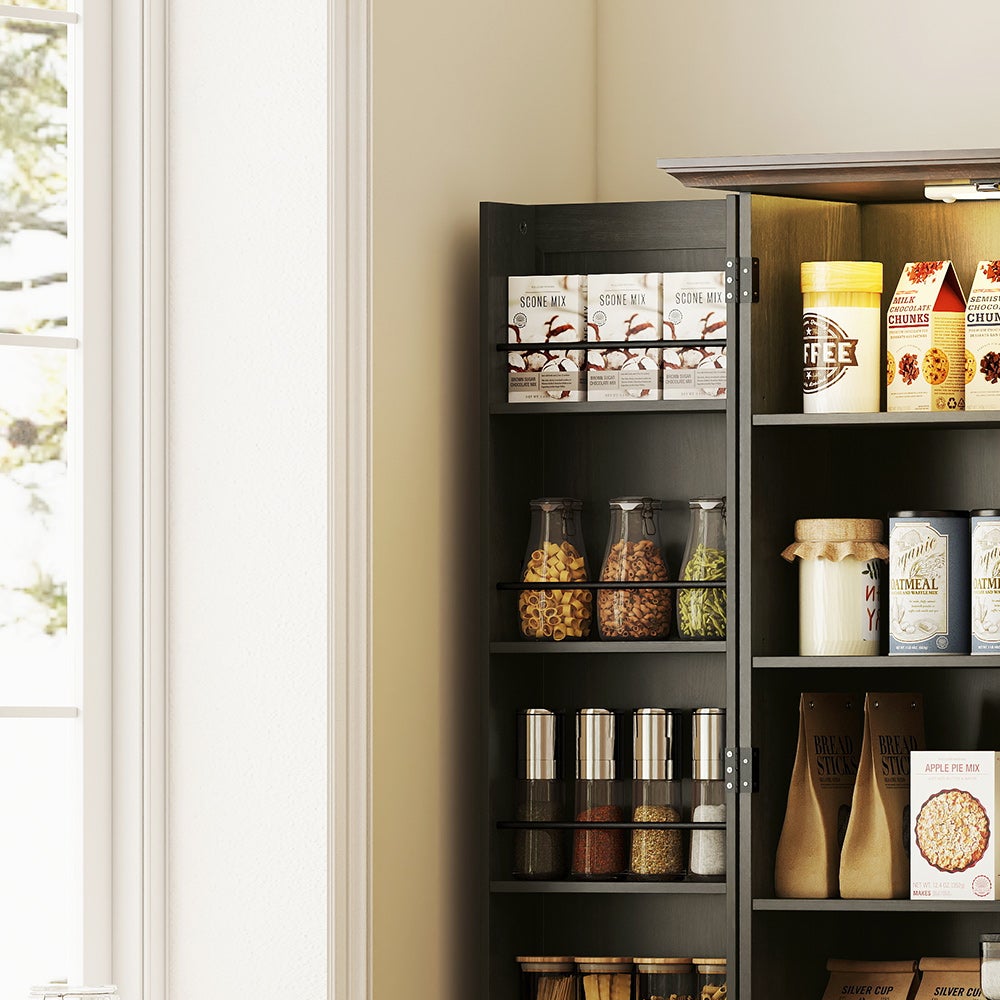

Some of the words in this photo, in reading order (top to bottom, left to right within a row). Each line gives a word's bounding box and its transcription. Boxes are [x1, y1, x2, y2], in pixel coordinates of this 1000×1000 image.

[520, 296, 547, 308] SCONE
[551, 295, 566, 307] MIX
[600, 294, 627, 306] SCONE
[630, 294, 646, 305] MIX
[676, 292, 702, 304] SCONE
[707, 292, 722, 303] MIX
[889, 314, 929, 324] CHUNKS
[804, 342, 852, 364] FFEE
[814, 736, 852, 754] BREAD
[879, 736, 918, 754] BREAD
[882, 756, 911, 775] STIC
[925, 764, 949, 772] APPLE
[951, 764, 963, 772] PIE
[966, 764, 980, 772] MIX
[842, 986, 872, 994] SILVER
[874, 986, 894, 995] CUP
[934, 987, 965, 996] SILVER
